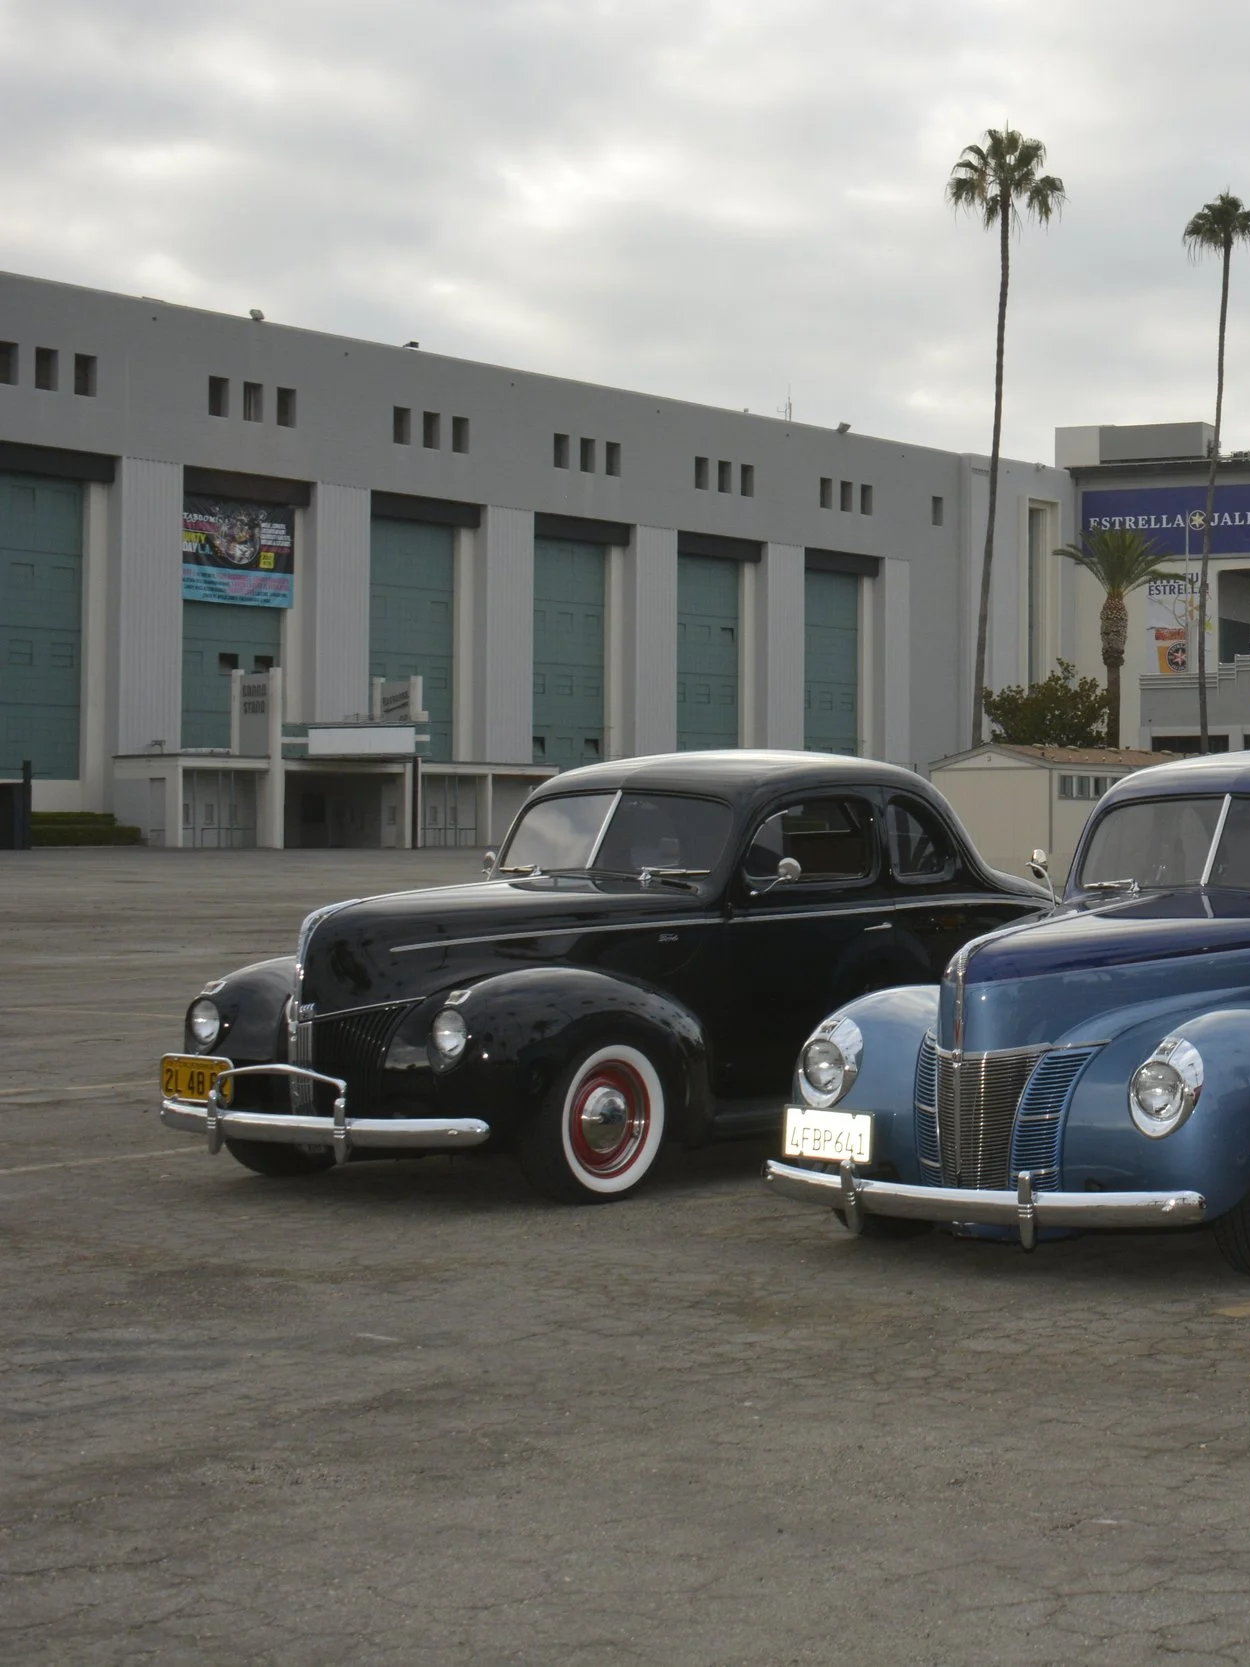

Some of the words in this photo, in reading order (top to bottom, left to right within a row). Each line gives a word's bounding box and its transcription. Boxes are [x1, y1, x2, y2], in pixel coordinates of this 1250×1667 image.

[1089, 514, 1185, 531] ESTRELLA
[1148, 583, 1209, 596] ESTRELL
[790, 1126, 864, 1156] 4FBP641
